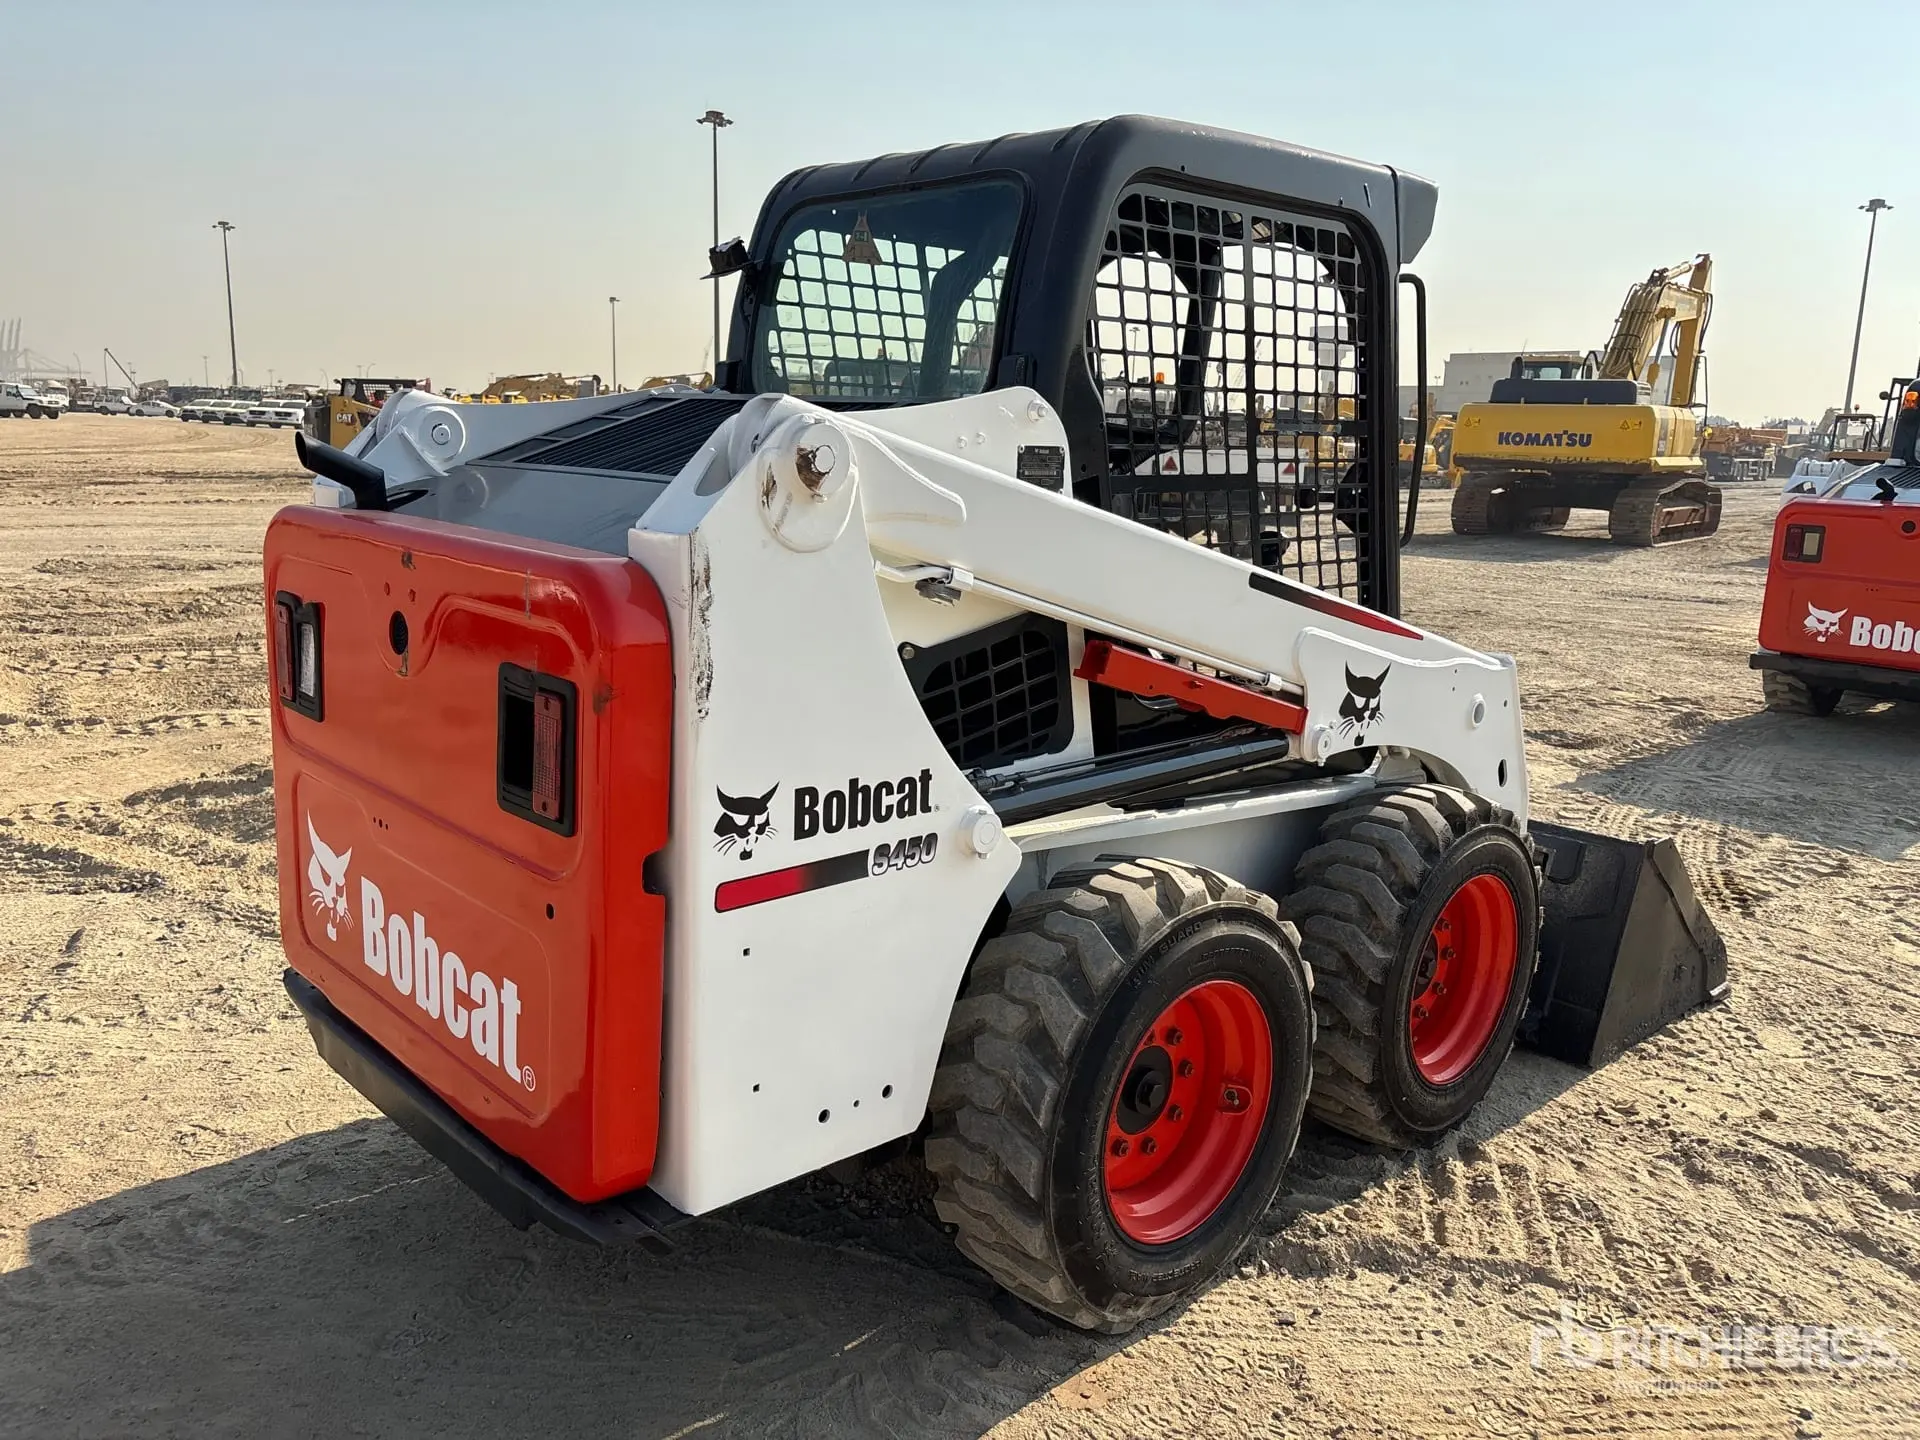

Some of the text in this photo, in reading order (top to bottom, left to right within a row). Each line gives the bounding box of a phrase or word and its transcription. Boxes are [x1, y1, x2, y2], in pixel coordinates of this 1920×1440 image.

[336, 413, 353, 423] CAT
[1498, 430, 1592, 447] KOMATSU
[793, 768, 932, 841] Bobcat
[872, 832, 938, 876] S450
[1158, 921, 1202, 955] GUARD
[360, 875, 522, 1084] Bobcat
